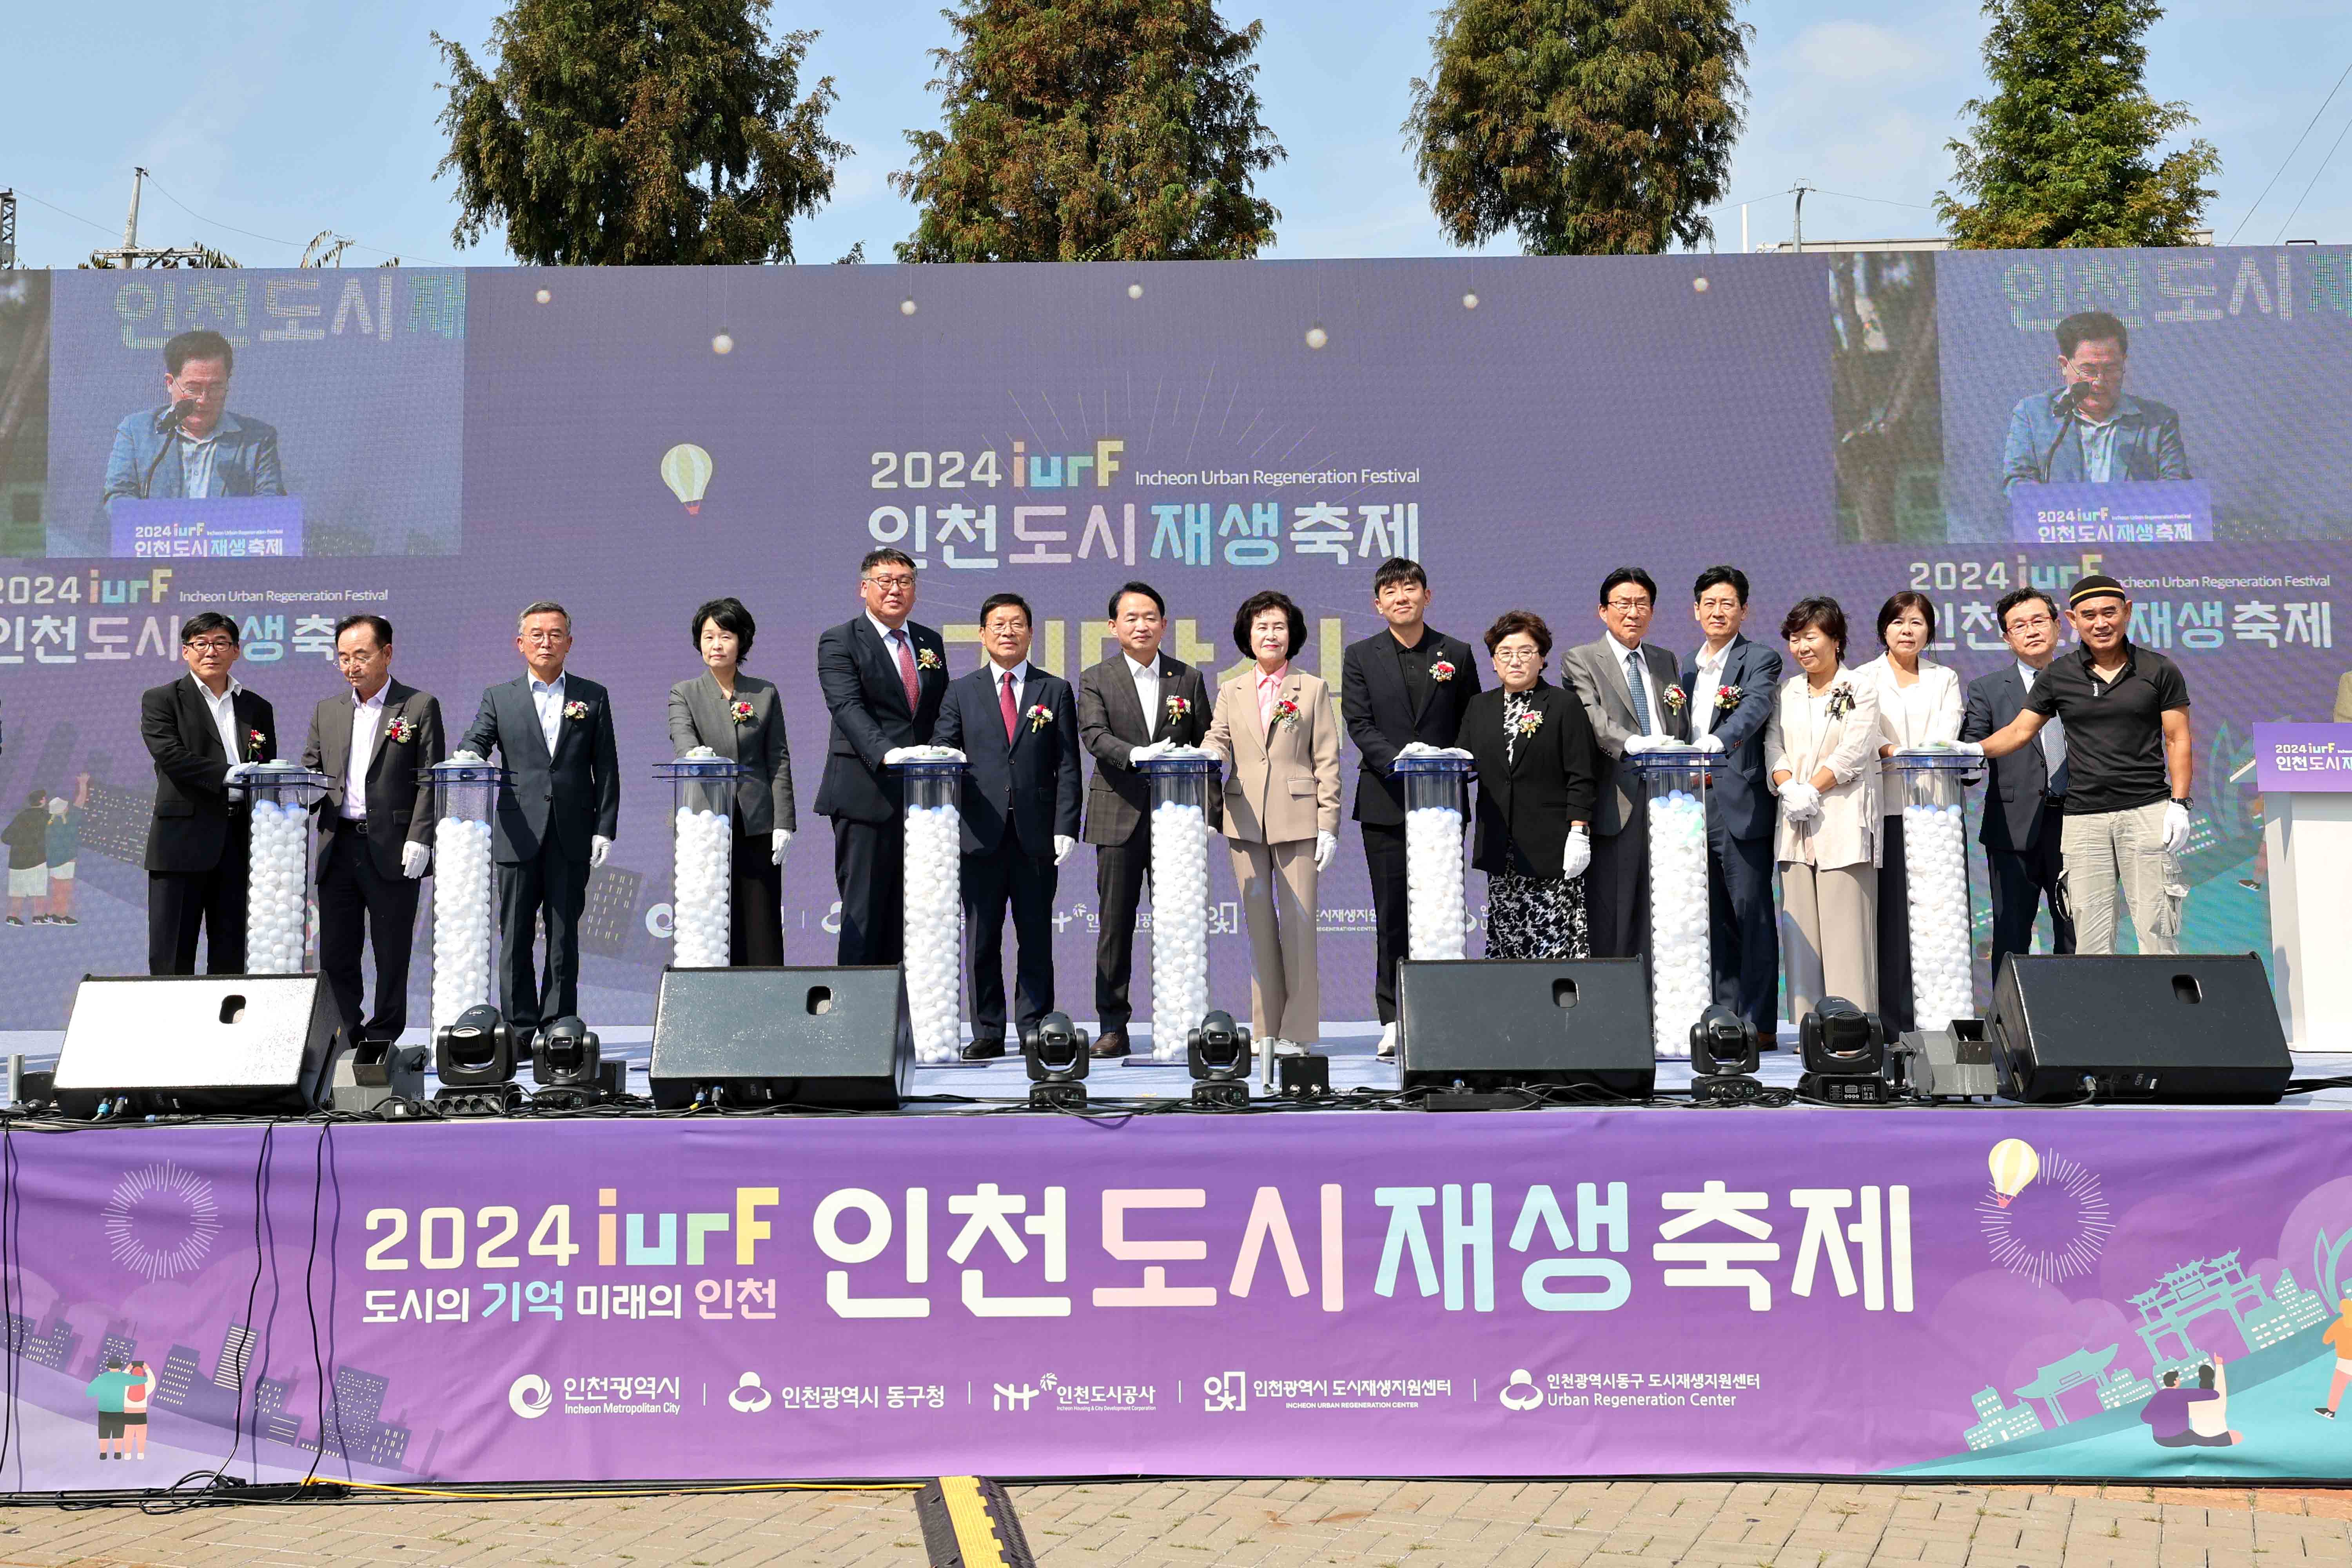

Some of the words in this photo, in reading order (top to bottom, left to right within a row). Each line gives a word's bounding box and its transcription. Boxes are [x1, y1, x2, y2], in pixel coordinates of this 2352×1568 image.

[871, 451, 1002, 488] 2024
[1013, 440, 1123, 487] iurF
[1136, 471, 1197, 485] Incheon
[1201, 470, 1249, 485] Urban
[1254, 469, 1357, 486] Regeneration
[1361, 468, 1419, 483] Festival
[2038, 510, 2076, 523] 2024
[135, 526, 172, 537] 2024
[0, 577, 81, 603] 024
[90, 568, 172, 603] iurF
[179, 591, 226, 602] Incheon
[229, 590, 264, 602] Urban
[266, 590, 342, 603] Regeneration
[345, 589, 388, 601] Festival
[1909, 562, 2010, 590] 2024
[2162, 576, 2200, 588] Urban
[2201, 575, 2282, 590] Regeneration
[2285, 575, 2330, 587] Festival
[2275, 744, 2307, 753] 2024
[2308, 743, 2335, 753] iurF
[365, 1204, 579, 1270] 2024
[598, 1187, 779, 1265] iurF
[362, 1287, 470, 1324] 도시의
[481, 1280, 564, 1322] 기억
[577, 1284, 682, 1320] 미래의
[694, 1277, 777, 1320] 인천
[563, 1376, 680, 1401] 인천광역시
[1253, 1379, 1328, 1397] 인천광역시
[1332, 1379, 1451, 1397] 도시재생지원센터
[1546, 1373, 1644, 1390] 인천광역시동구
[1648, 1373, 1760, 1390] 도시재생지원센터
[782, 1385, 878, 1409] 인천광역시
[886, 1385, 945, 1408] 동구청
[1056, 1385, 1156, 1405] 인천도시공사
[1547, 1392, 1590, 1407] Urban
[1594, 1392, 1686, 1408] Regeneration
[1690, 1392, 1737, 1407] Center
[564, 1403, 601, 1414] Incheon
[603, 1402, 661, 1415] Metropolitan
[663, 1402, 681, 1415] City
